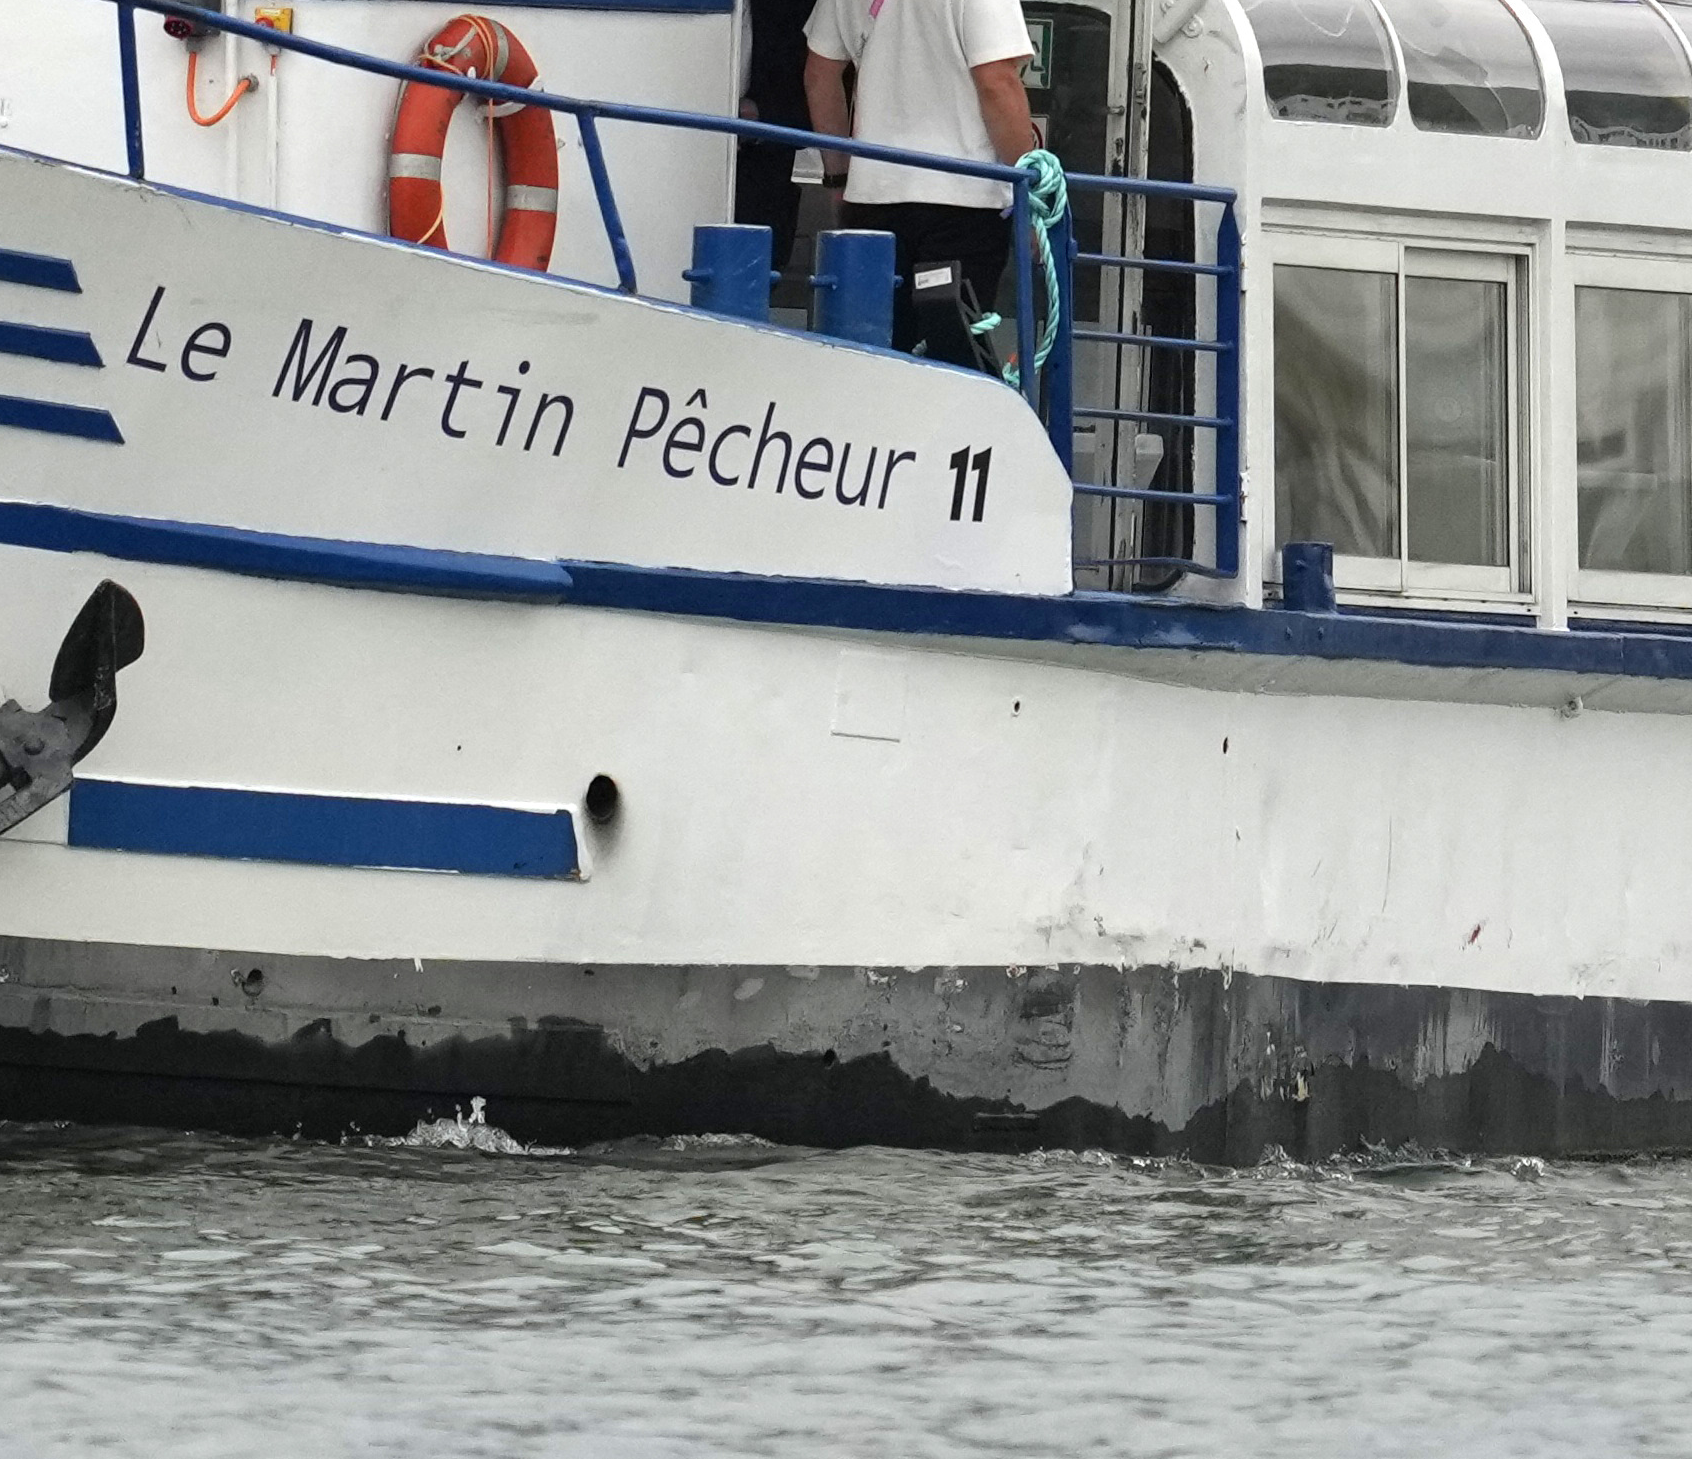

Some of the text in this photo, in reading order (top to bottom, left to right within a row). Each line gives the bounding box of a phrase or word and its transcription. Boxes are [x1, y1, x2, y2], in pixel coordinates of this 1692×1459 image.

[126, 285, 993, 523] Le Martin Pêcheur 11
